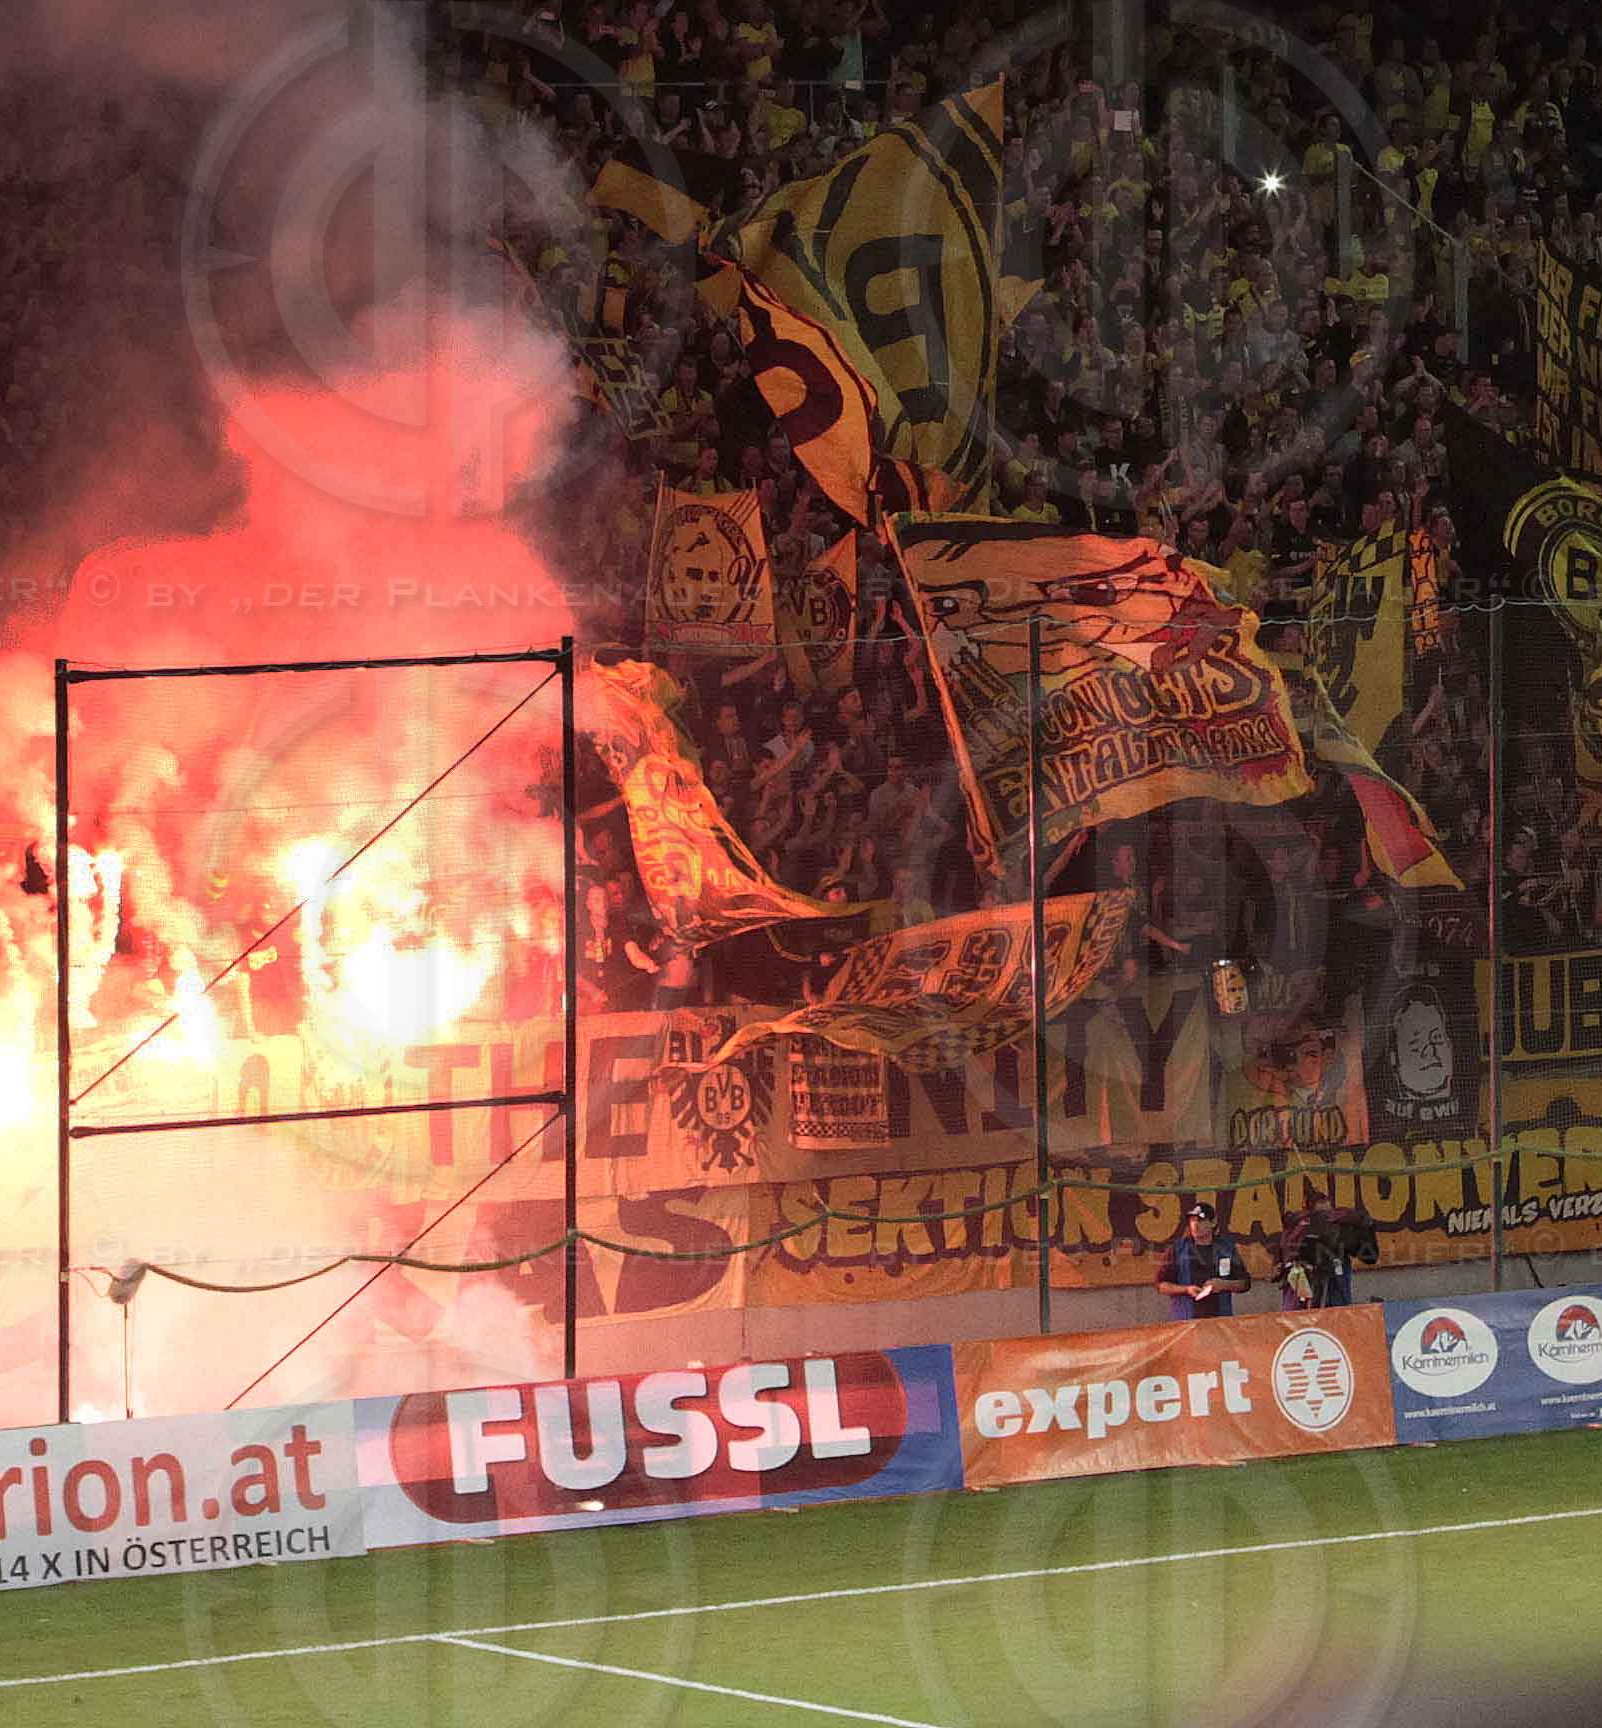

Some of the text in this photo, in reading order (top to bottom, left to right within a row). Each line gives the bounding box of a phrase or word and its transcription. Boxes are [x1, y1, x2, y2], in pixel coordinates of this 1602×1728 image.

[780, 1162, 1113, 1262] SEKTION
[1446, 1197, 1539, 1237] NIEMALS
[445, 1358, 872, 1496] FUSSL
[974, 1359, 1251, 1442] expert
[41, 1554, 64, 1582] X
[77, 1549, 110, 1579] IN
[123, 1524, 332, 1572] ÖSTERREICH
